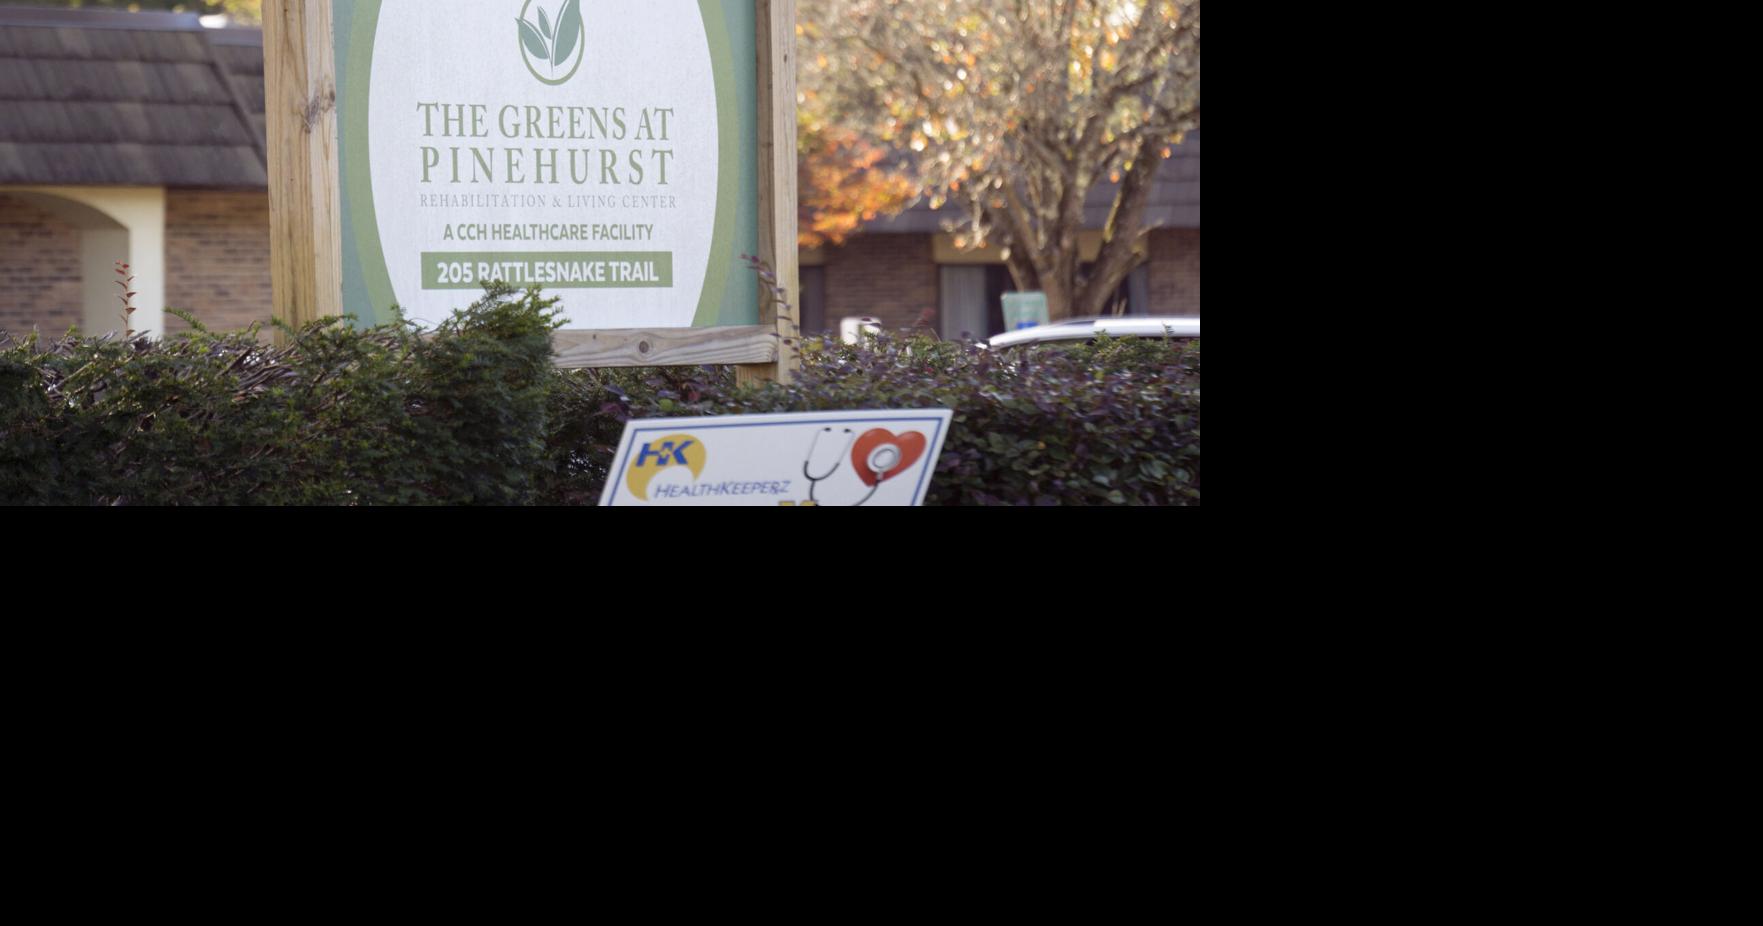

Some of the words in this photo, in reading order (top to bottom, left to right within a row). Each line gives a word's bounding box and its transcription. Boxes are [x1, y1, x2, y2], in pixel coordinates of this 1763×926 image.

[416, 102, 488, 137] THE
[498, 104, 626, 140] GREENS
[634, 107, 674, 141] AT
[420, 147, 674, 185] PINEHURST
[420, 193, 546, 207] REHABILITATION
[552, 197, 562, 207] &
[568, 196, 616, 208] LIVING
[622, 196, 676, 209] CENTER
[444, 224, 453, 240] A
[457, 224, 487, 240] CCH
[492, 224, 587, 241] HEALTHCARE
[592, 224, 653, 241] FACILITY
[437, 262, 473, 283] 205
[478, 261, 605, 283] RATTLESNAKE
[609, 262, 659, 281] TRAIL
